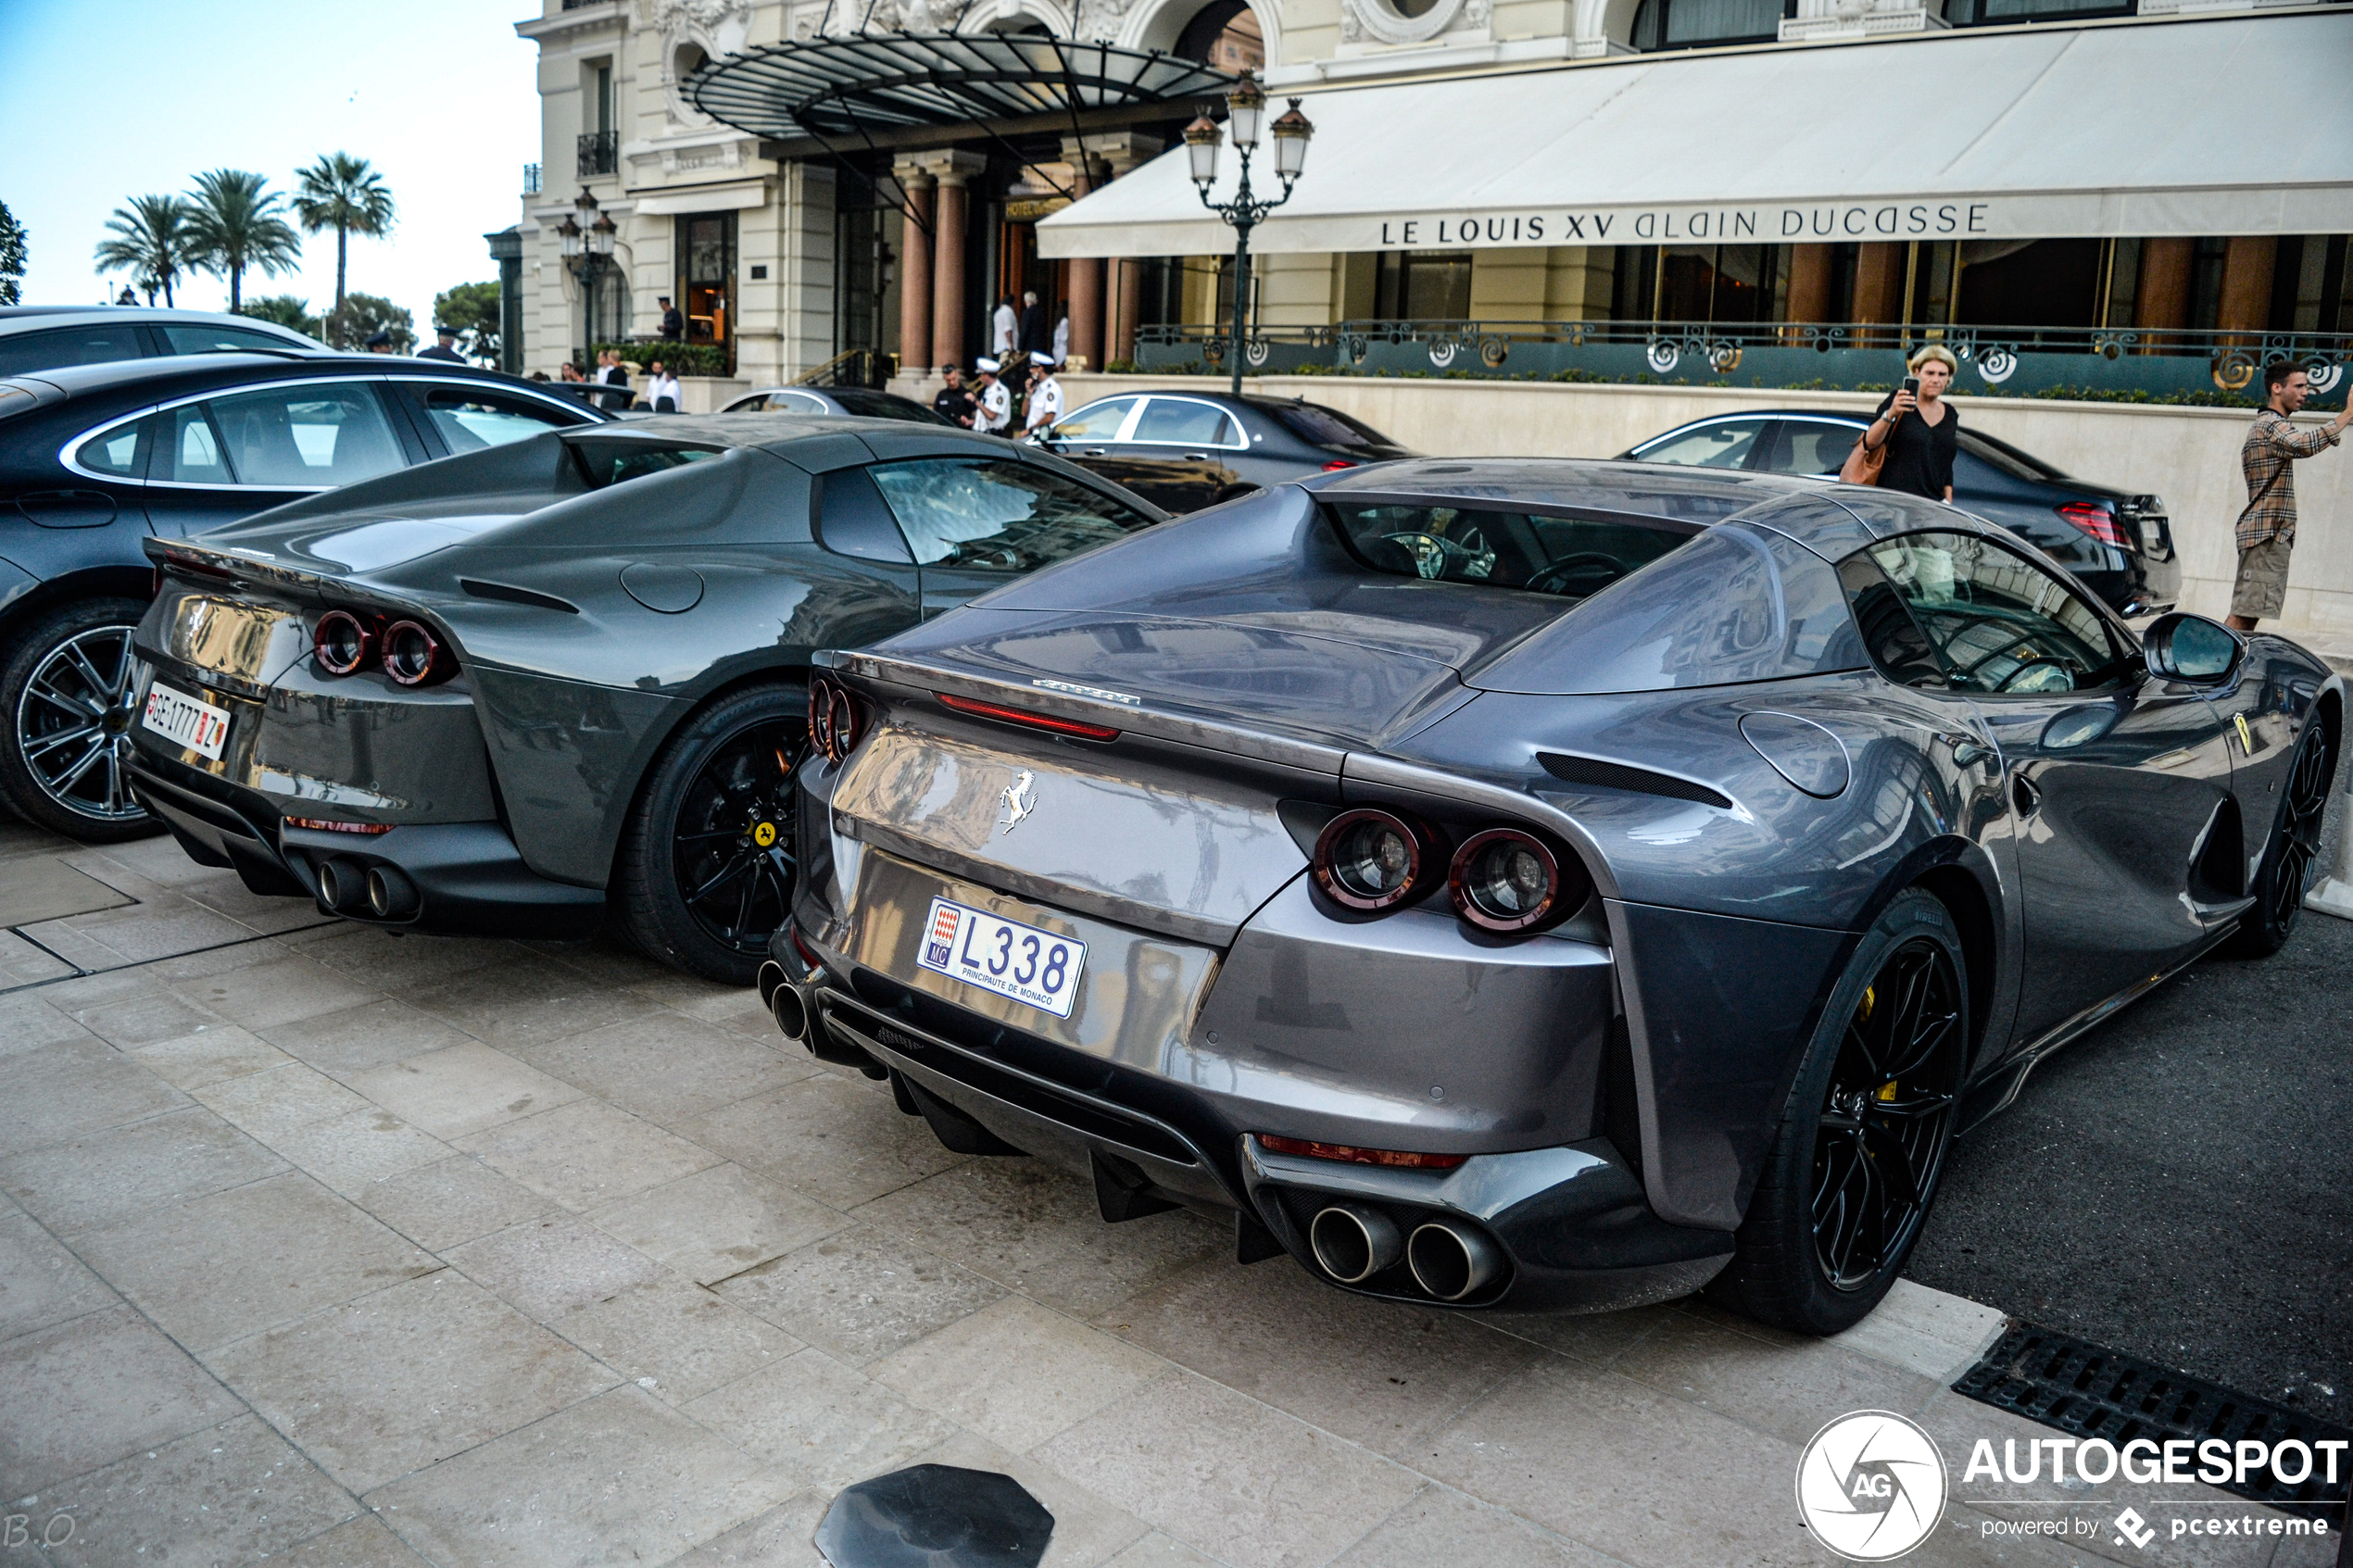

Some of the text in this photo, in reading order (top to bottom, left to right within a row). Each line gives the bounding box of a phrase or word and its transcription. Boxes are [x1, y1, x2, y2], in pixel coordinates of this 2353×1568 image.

[1382, 205, 1989, 245] LE LOUIS XV ALAIN DUCASSE
[930, 947, 948, 965] MC
[960, 915, 1069, 995] L338
[962, 967, 1052, 1006] PRINCIPAUTE DE MONACO
